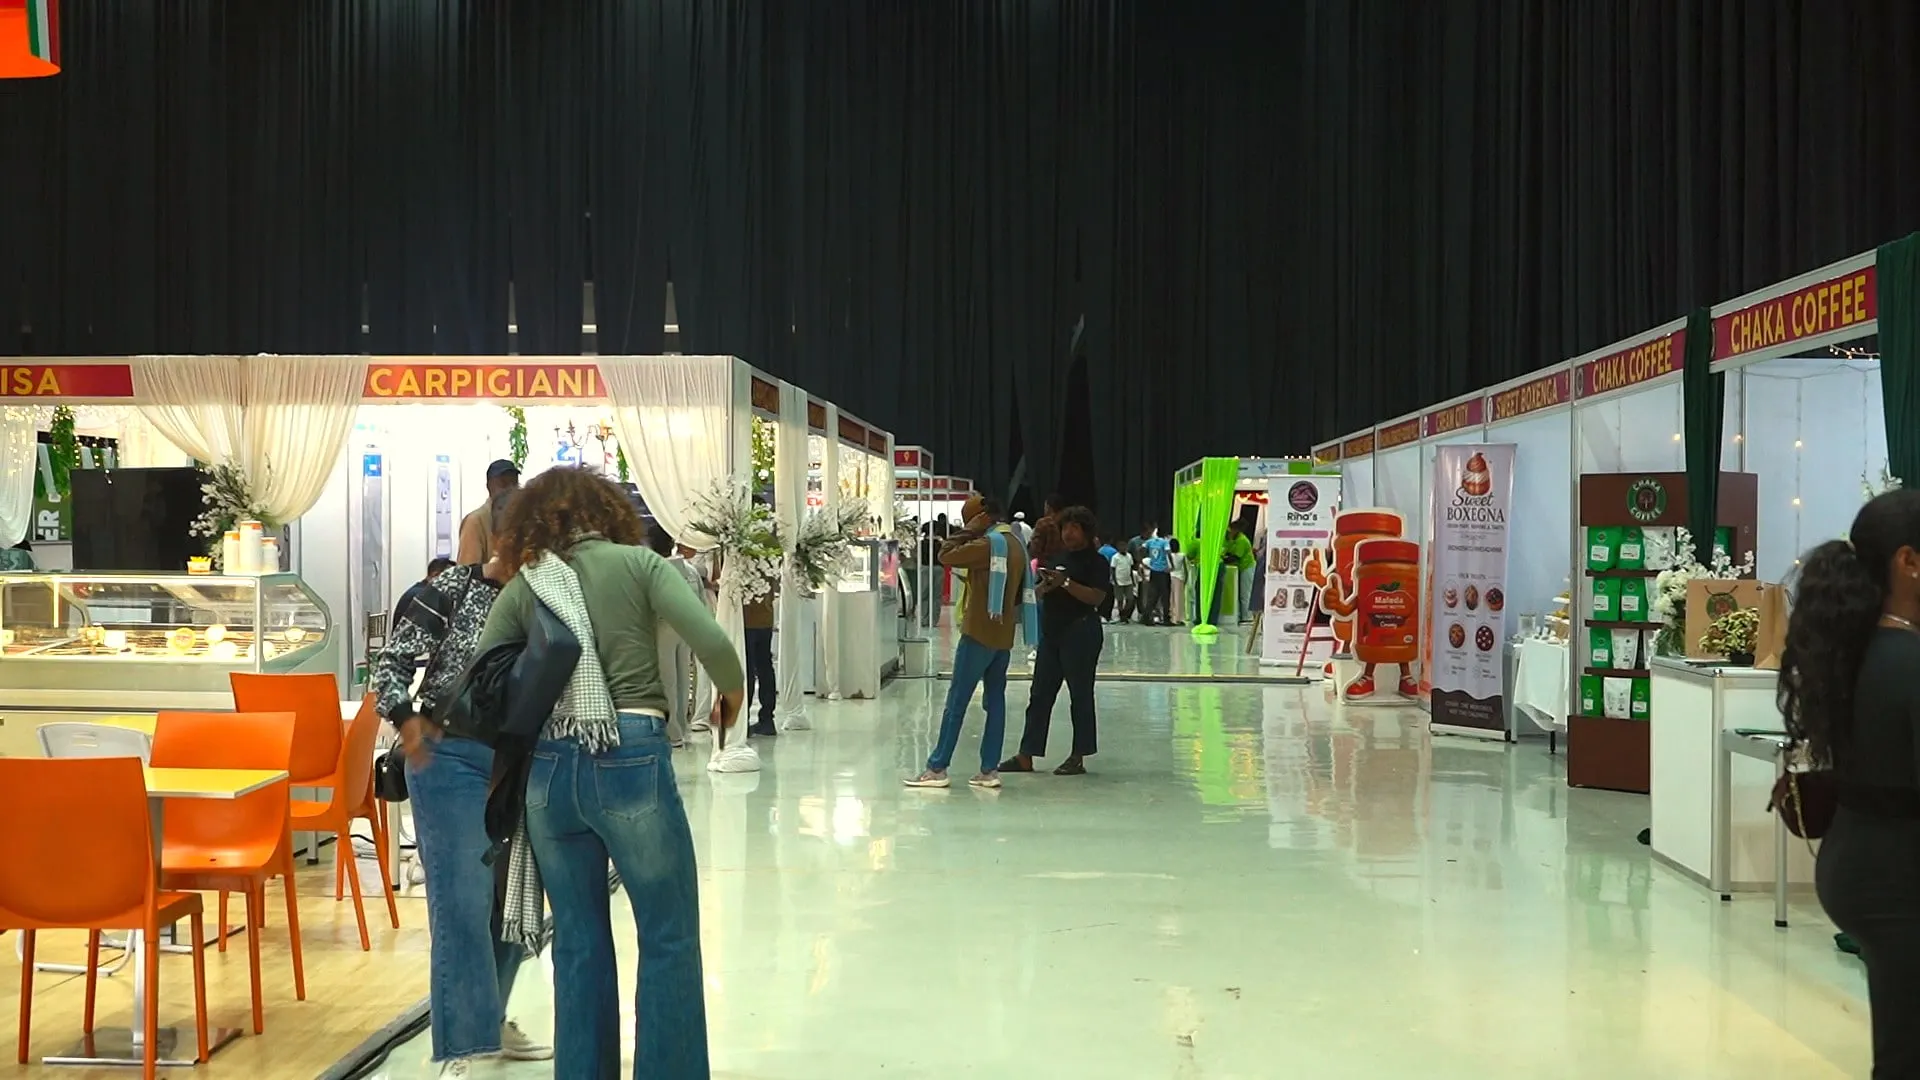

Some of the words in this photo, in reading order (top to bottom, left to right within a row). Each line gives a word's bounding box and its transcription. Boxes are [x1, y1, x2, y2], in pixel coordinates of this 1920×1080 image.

[1730, 302, 1786, 354] CHAKA
[1791, 275, 1867, 337] COFFEE
[1592, 355, 1627, 393] CHAKA
[1628, 337, 1673, 382] COFFEE
[0, 367, 61, 396] ISA
[369, 368, 596, 397] CARPIGIANI
[1452, 486, 1495, 507] Sweet
[1446, 506, 1505, 523] BOXEGNA
